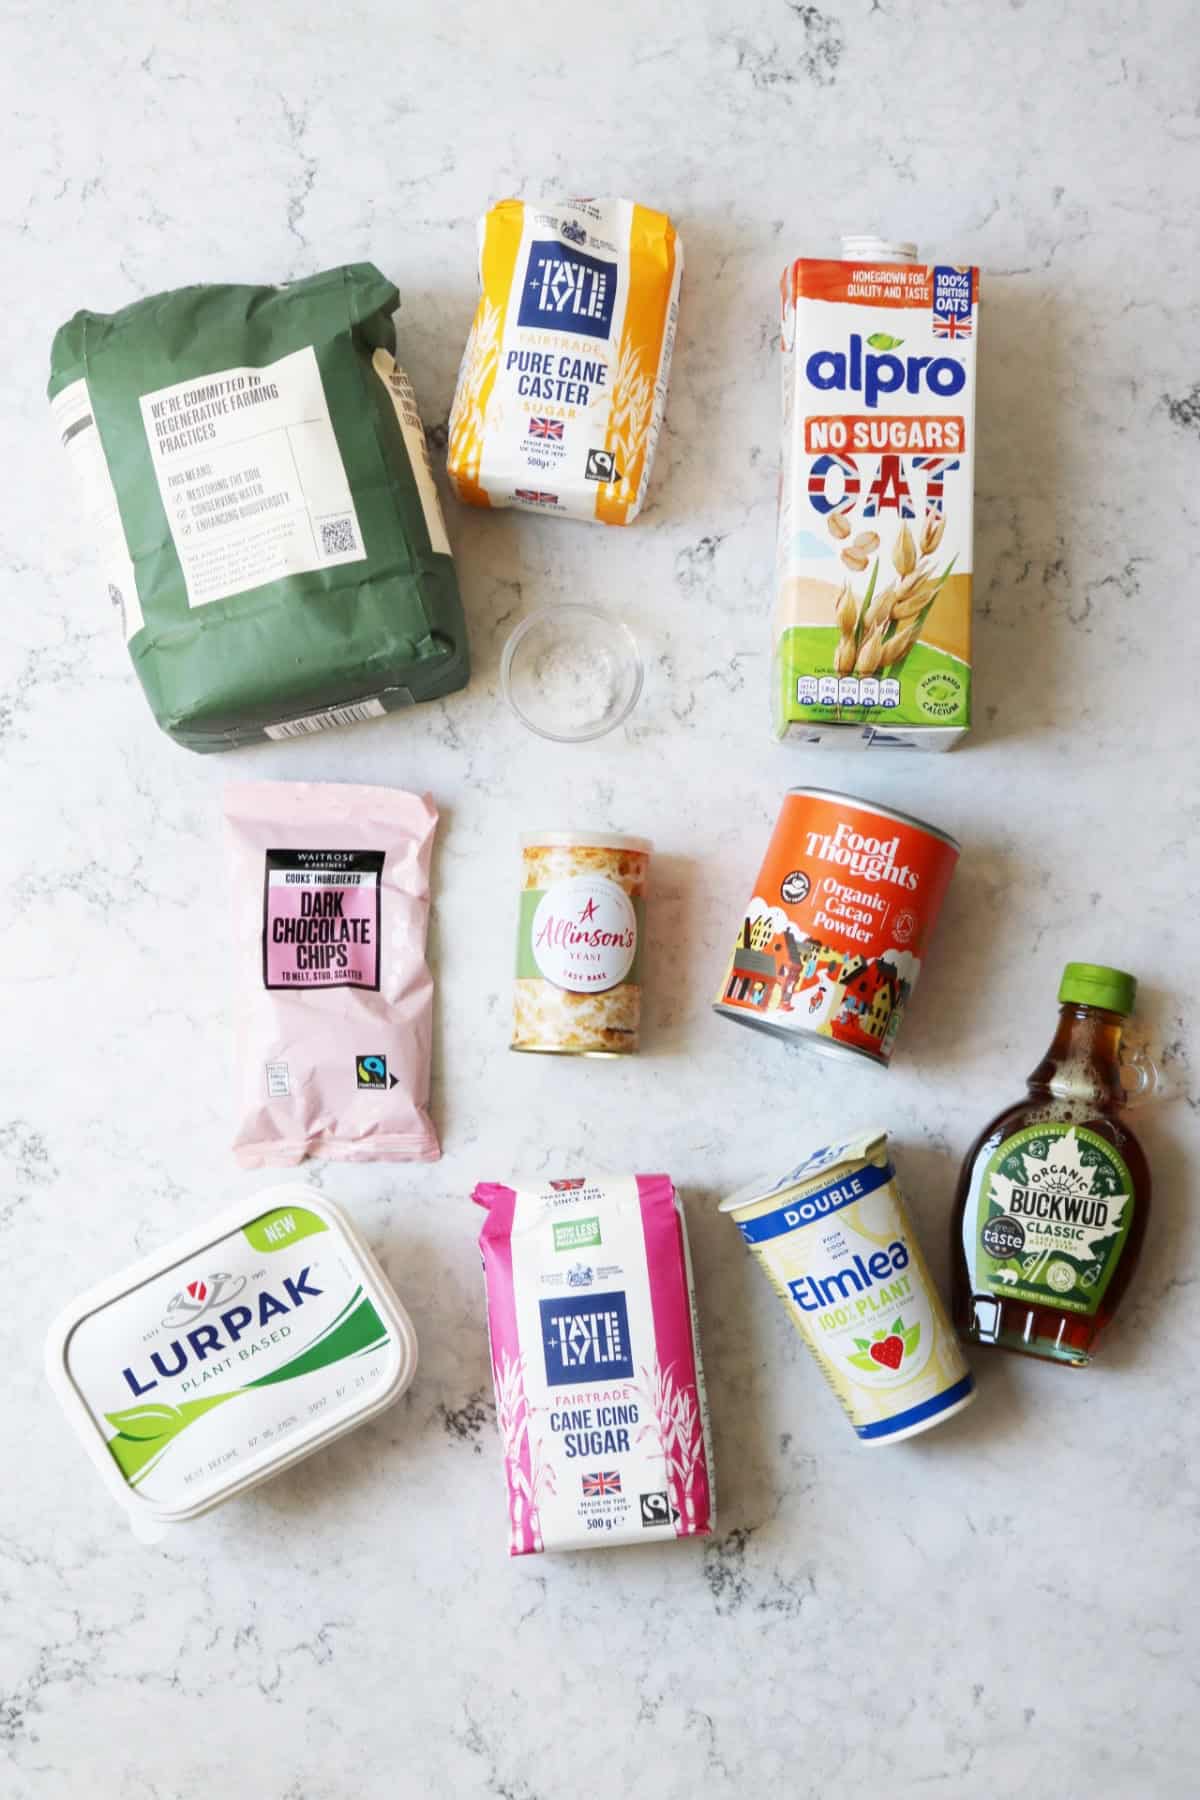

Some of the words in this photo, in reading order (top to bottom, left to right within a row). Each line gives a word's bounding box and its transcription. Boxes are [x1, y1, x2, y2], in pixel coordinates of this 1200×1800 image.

[847, 284, 882, 298] QUALITY
[883, 286, 902, 299] AND
[904, 287, 930, 300] TASTE
[852, 270, 907, 284] HOMEGROWN
[908, 274, 927, 285] FOR
[936, 273, 969, 288] 100%
[936, 286, 969, 298] BRITISH
[935, 296, 969, 313] OATS
[507, 350, 555, 376] PURE
[558, 356, 609, 387] CANE
[805, 332, 967, 409] alpro
[151, 394, 184, 420] WE'RE
[183, 377, 247, 408] COMMITTED
[517, 375, 590, 406] CASTER
[155, 397, 231, 439] REGENERATIVE
[230, 382, 280, 411] FARMING
[522, 401, 577, 417] SUGAR
[159, 422, 217, 456] PRACTICES
[809, 420, 849, 449] NO
[852, 421, 962, 449] SUGARS
[808, 454, 961, 521] OAT
[921, 701, 960, 716] CALCIUM
[832, 822, 901, 859] Food
[297, 853, 354, 863] WAITROSE
[804, 831, 920, 892] Thoughts
[285, 872, 314, 884] COOKS'
[313, 873, 362, 885] INGREDIENTS
[300, 891, 346, 918] DARK
[822, 876, 887, 912] Organic
[824, 896, 874, 926] Cacao
[272, 917, 372, 945] CHOCOLATE
[535, 916, 635, 950] Allinson's
[812, 910, 875, 944] Powder
[296, 944, 348, 971] CHIPS
[569, 952, 602, 961] YEAST
[1031, 1163, 1090, 1193] ORGANIC
[782, 1178, 865, 1227] DOUBLE
[1008, 1187, 1109, 1228] BUCKWUD
[264, 1213, 298, 1244] NEW
[984, 1229, 1023, 1249] taste
[1026, 1221, 1085, 1241] CLASSIC
[785, 1240, 909, 1312] Elmlea
[819, 1303, 854, 1331] 100%
[854, 1274, 912, 1317] PLANT
[121, 1265, 324, 1398] LURPAK
[181, 1356, 234, 1393] PLANT
[237, 1325, 292, 1362] BASED
[555, 1388, 631, 1406] FAIRTRADE
[550, 1408, 593, 1433] CANE
[596, 1403, 640, 1429] ICING
[564, 1428, 631, 1458] SUGAR
